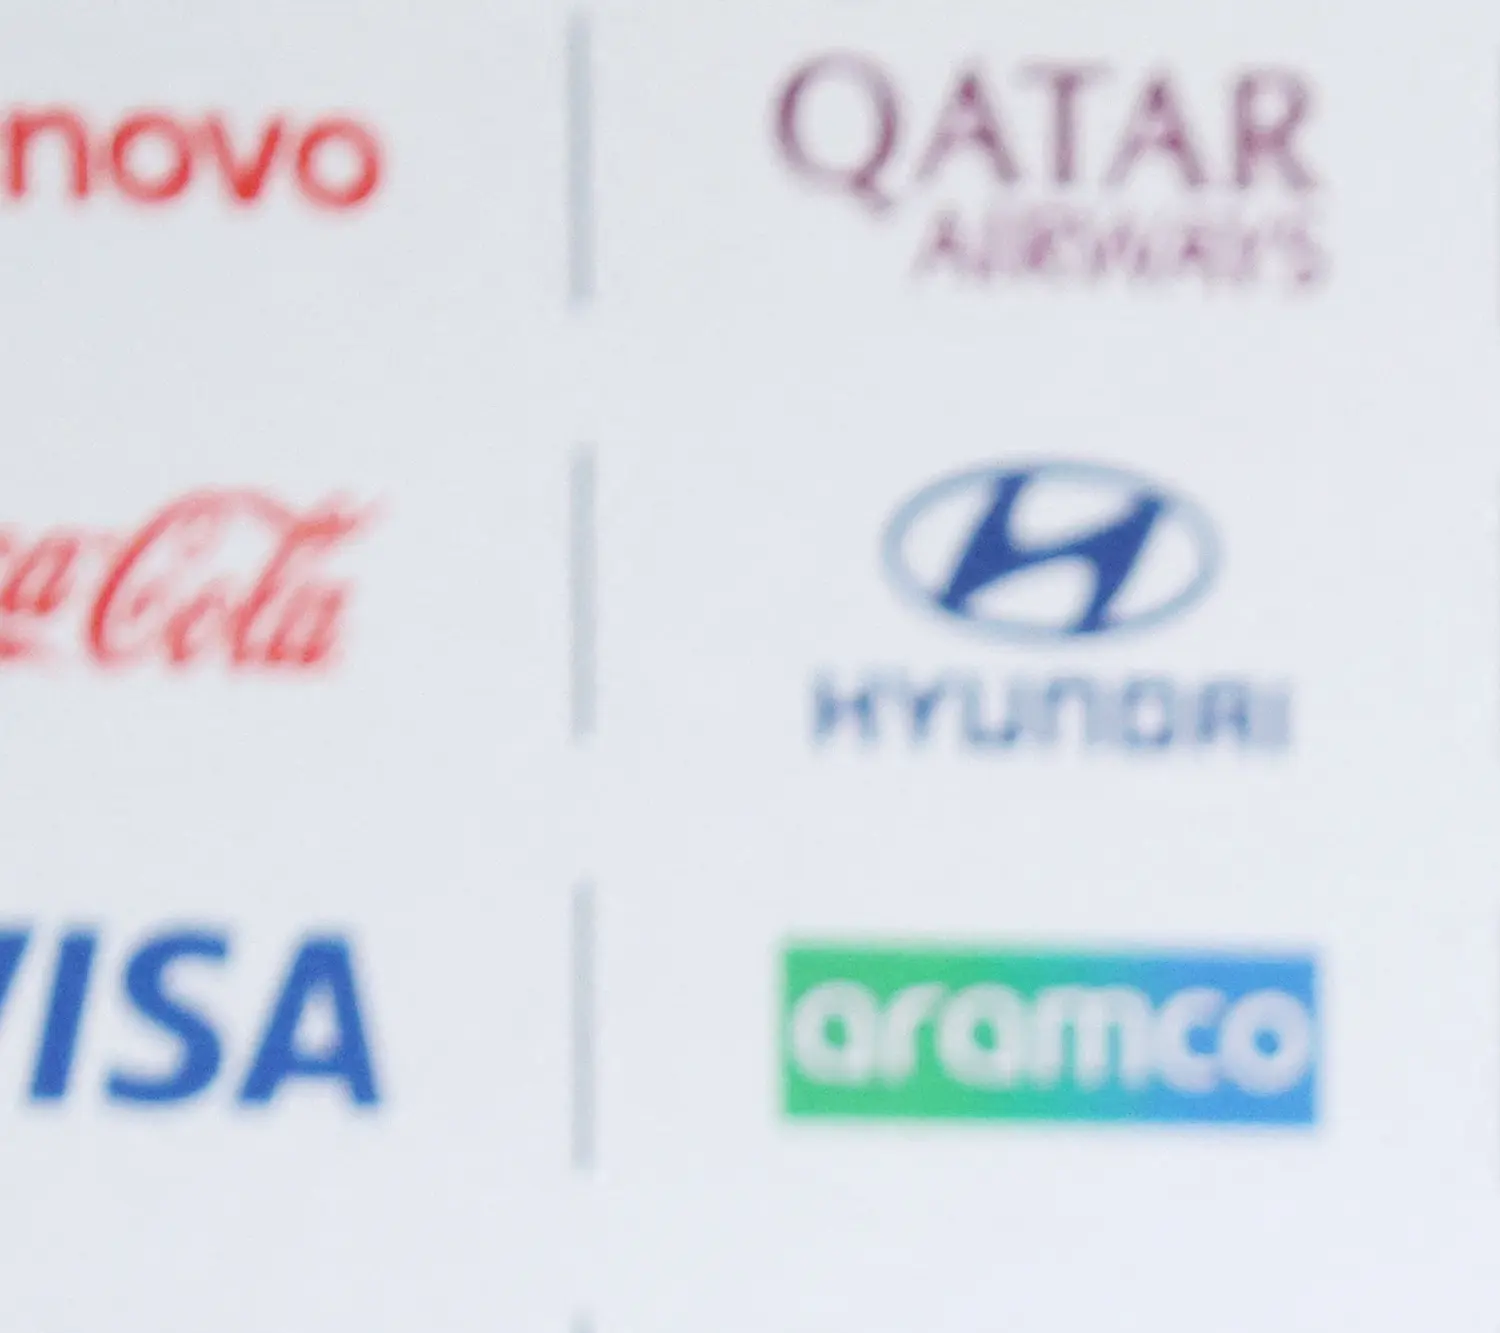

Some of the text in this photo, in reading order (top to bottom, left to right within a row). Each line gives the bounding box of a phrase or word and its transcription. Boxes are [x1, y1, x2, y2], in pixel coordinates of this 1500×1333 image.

[770, 52, 1320, 210] QATAR
[915, 208, 1328, 290] AIRWAYS
[808, 672, 1292, 757] HYUNDAI
[0, 923, 384, 1111] ISA
[795, 978, 1316, 1096] aramco
